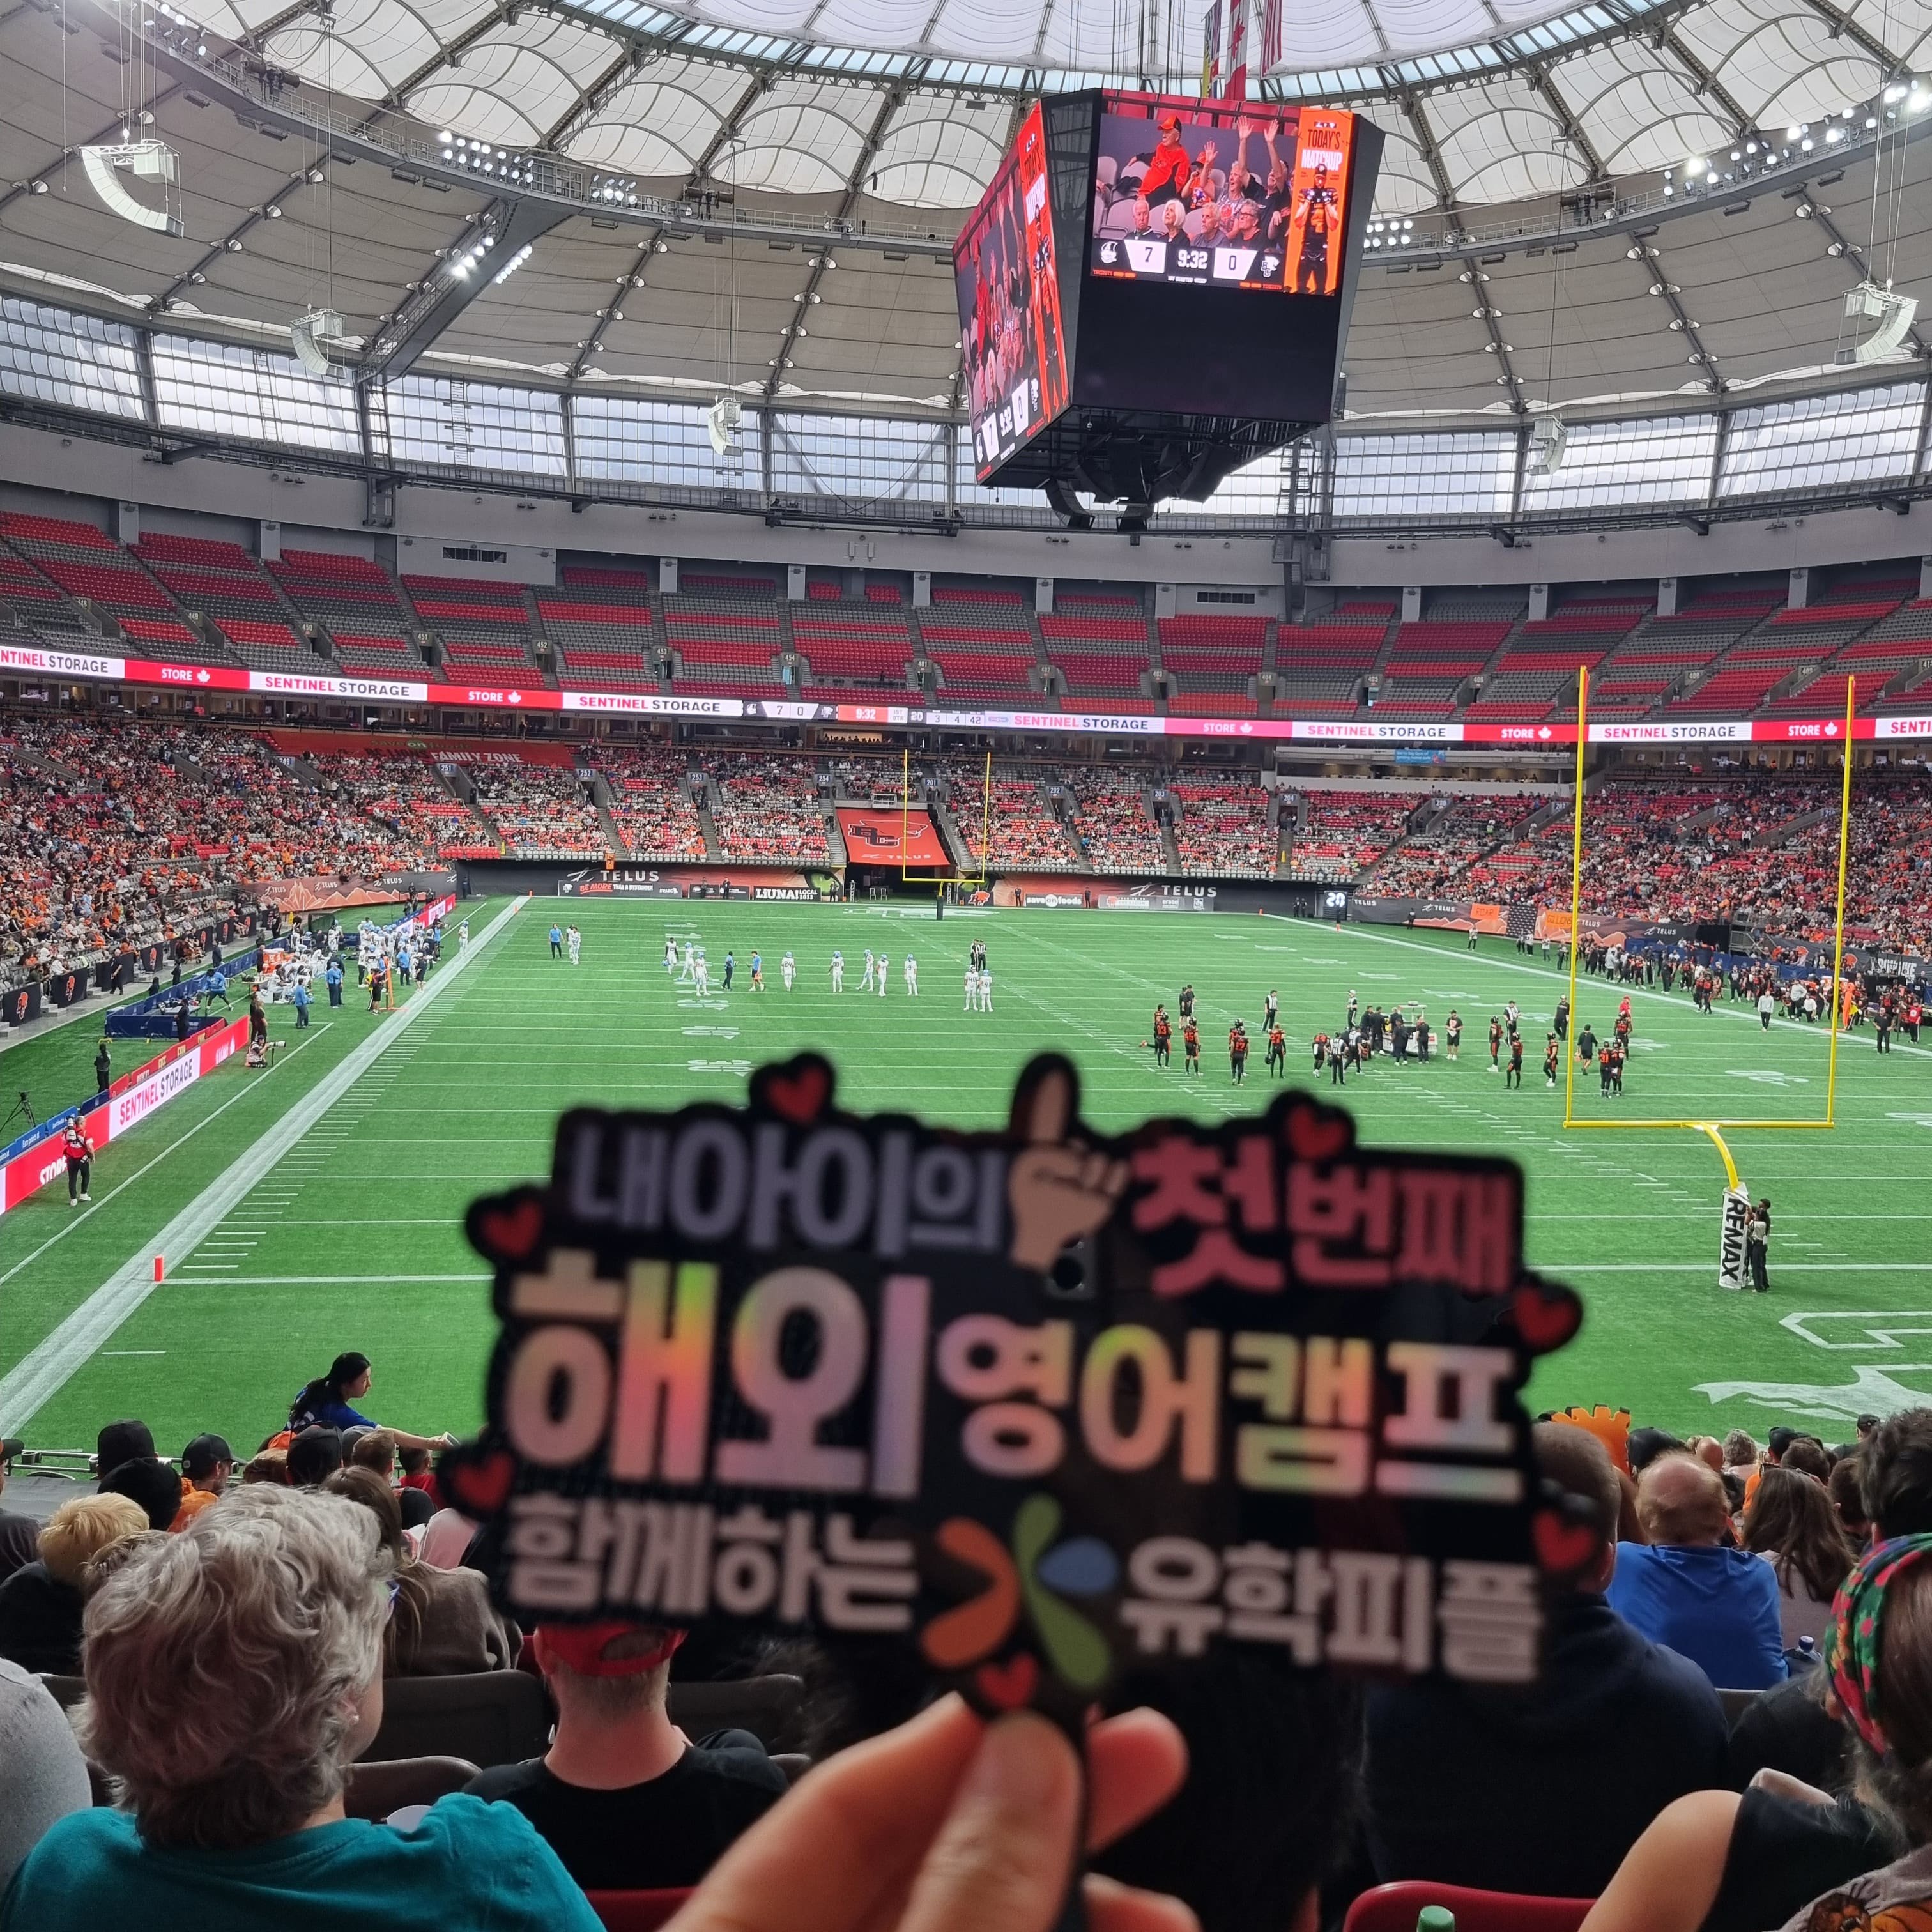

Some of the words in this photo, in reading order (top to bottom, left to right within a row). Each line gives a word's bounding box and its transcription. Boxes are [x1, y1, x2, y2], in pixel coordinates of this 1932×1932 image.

[1307, 130, 1341, 150] TODAY'S
[1144, 247, 1153, 263] 7
[1177, 249, 1208, 270] 9:32
[1228, 255, 1237, 271] 0
[1, 650, 46, 667] NTINEL
[49, 655, 109, 673] STORAGE
[161, 668, 192, 681] STORE
[265, 676, 335, 692] SENTINEL
[339, 682, 410, 697] STORAGE
[468, 691, 503, 702] STORE
[579, 696, 649, 709] SENTINEL
[652, 700, 721, 712] STORAGE
[776, 705, 783, 715] 7
[797, 707, 804, 716] 0
[855, 708, 876, 720] 9:32
[911, 711, 923, 721] 20
[935, 715, 940, 723] 3
[970, 716, 981, 724] 42
[1014, 715, 1079, 728] SENTINEL
[1082, 717, 1149, 730] STORAGE
[1203, 722, 1236, 733] STORE
[1307, 725, 1375, 737] SENTINEL
[1379, 726, 1446, 738] STORAGE
[1604, 727, 1667, 739] SENTINEL
[1671, 726, 1736, 738] STORAGE
[1788, 724, 1820, 737] STORE
[1891, 721, 1931, 733] SENTI
[1501, 728, 1535, 739] STORE
[431, 751, 480, 762] FAMILY
[484, 753, 524, 763] ZONE
[600, 870, 660, 882] TELUS
[590, 882, 612, 891] MORE
[1161, 885, 1217, 898] TELUS
[1581, 919, 1600, 927] TELUS
[1657, 927, 1676, 935] TELUS
[119, 1082, 159, 1126] SENTINEL
[160, 1058, 193, 1098] STORAGE
